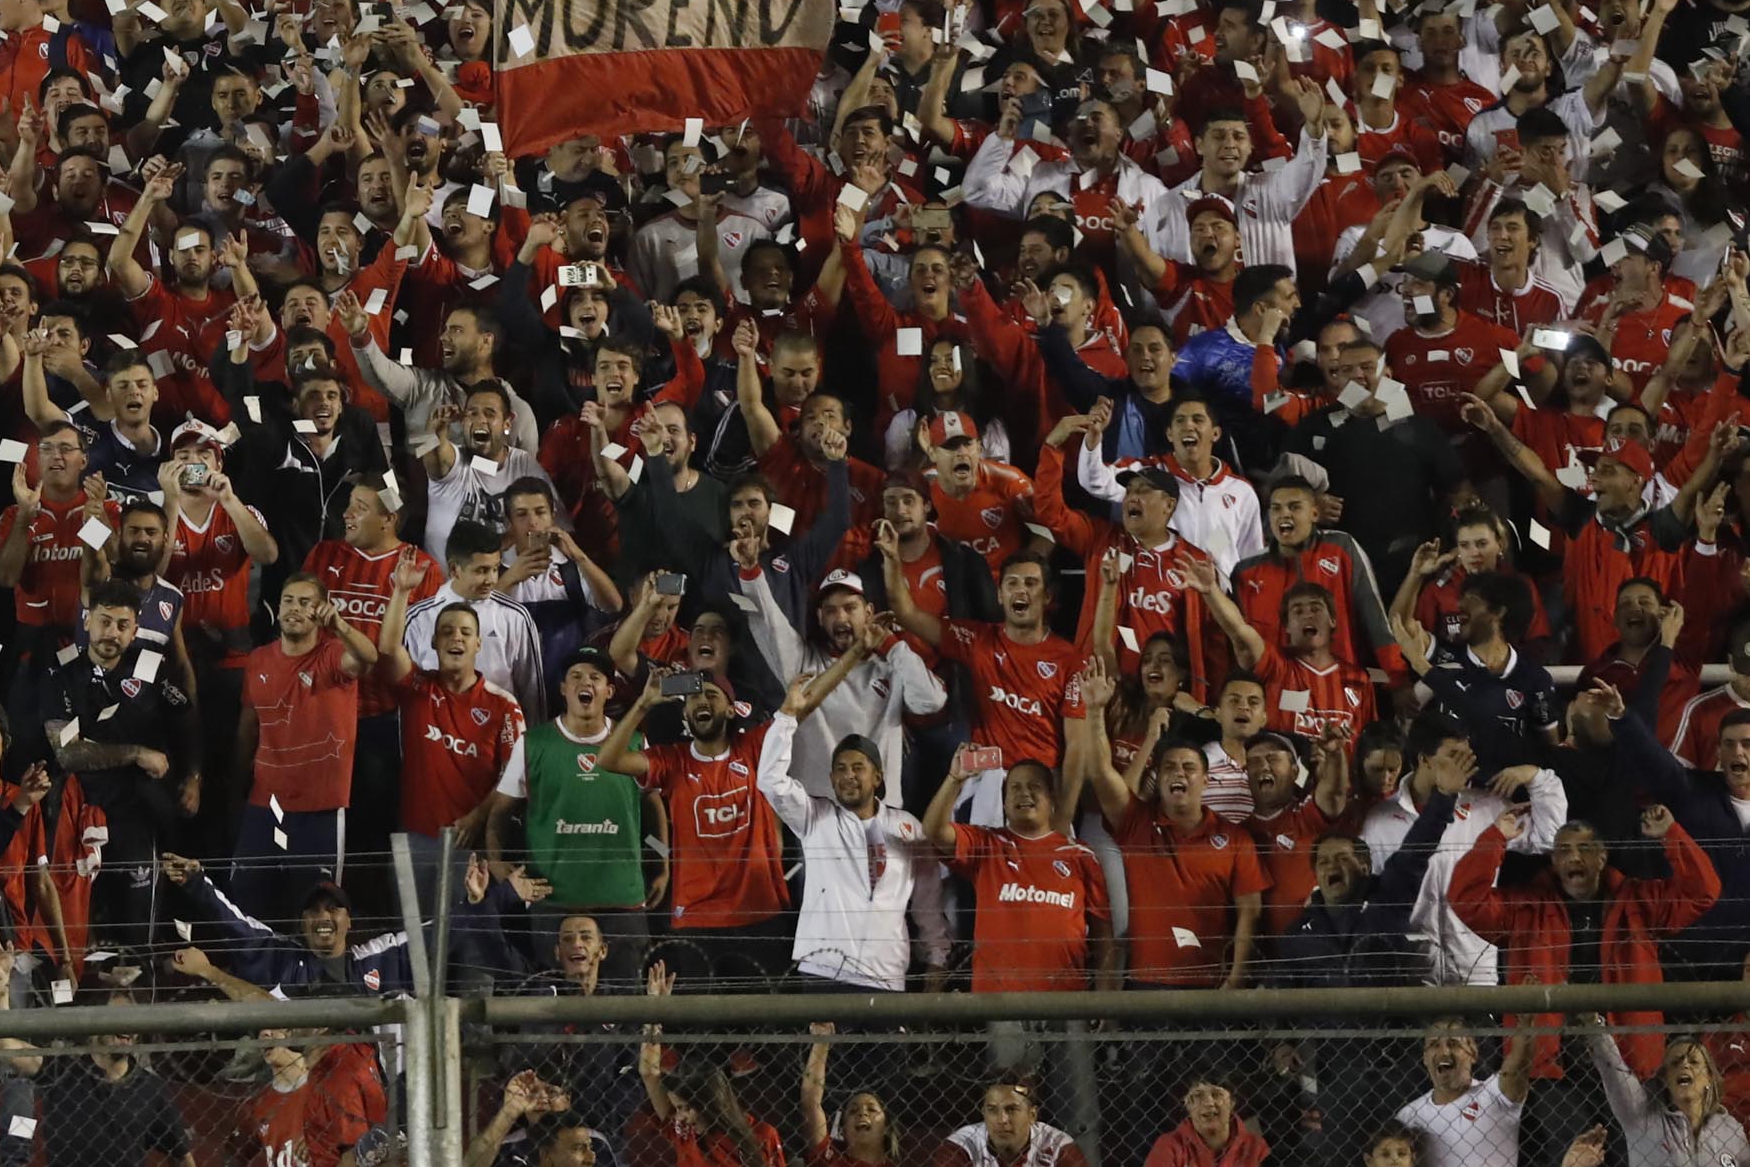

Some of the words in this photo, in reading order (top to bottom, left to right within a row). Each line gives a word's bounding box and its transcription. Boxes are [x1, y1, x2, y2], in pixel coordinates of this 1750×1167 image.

[1423, 386, 1456, 400] TCL
[180, 568, 225, 593] AdeS
[348, 598, 386, 617] OCA
[1005, 693, 1042, 716] OCA
[442, 733, 477, 758] OCA
[703, 803, 745, 824] TCL
[555, 818, 619, 835] taranto
[999, 882, 1075, 909] Motomel
